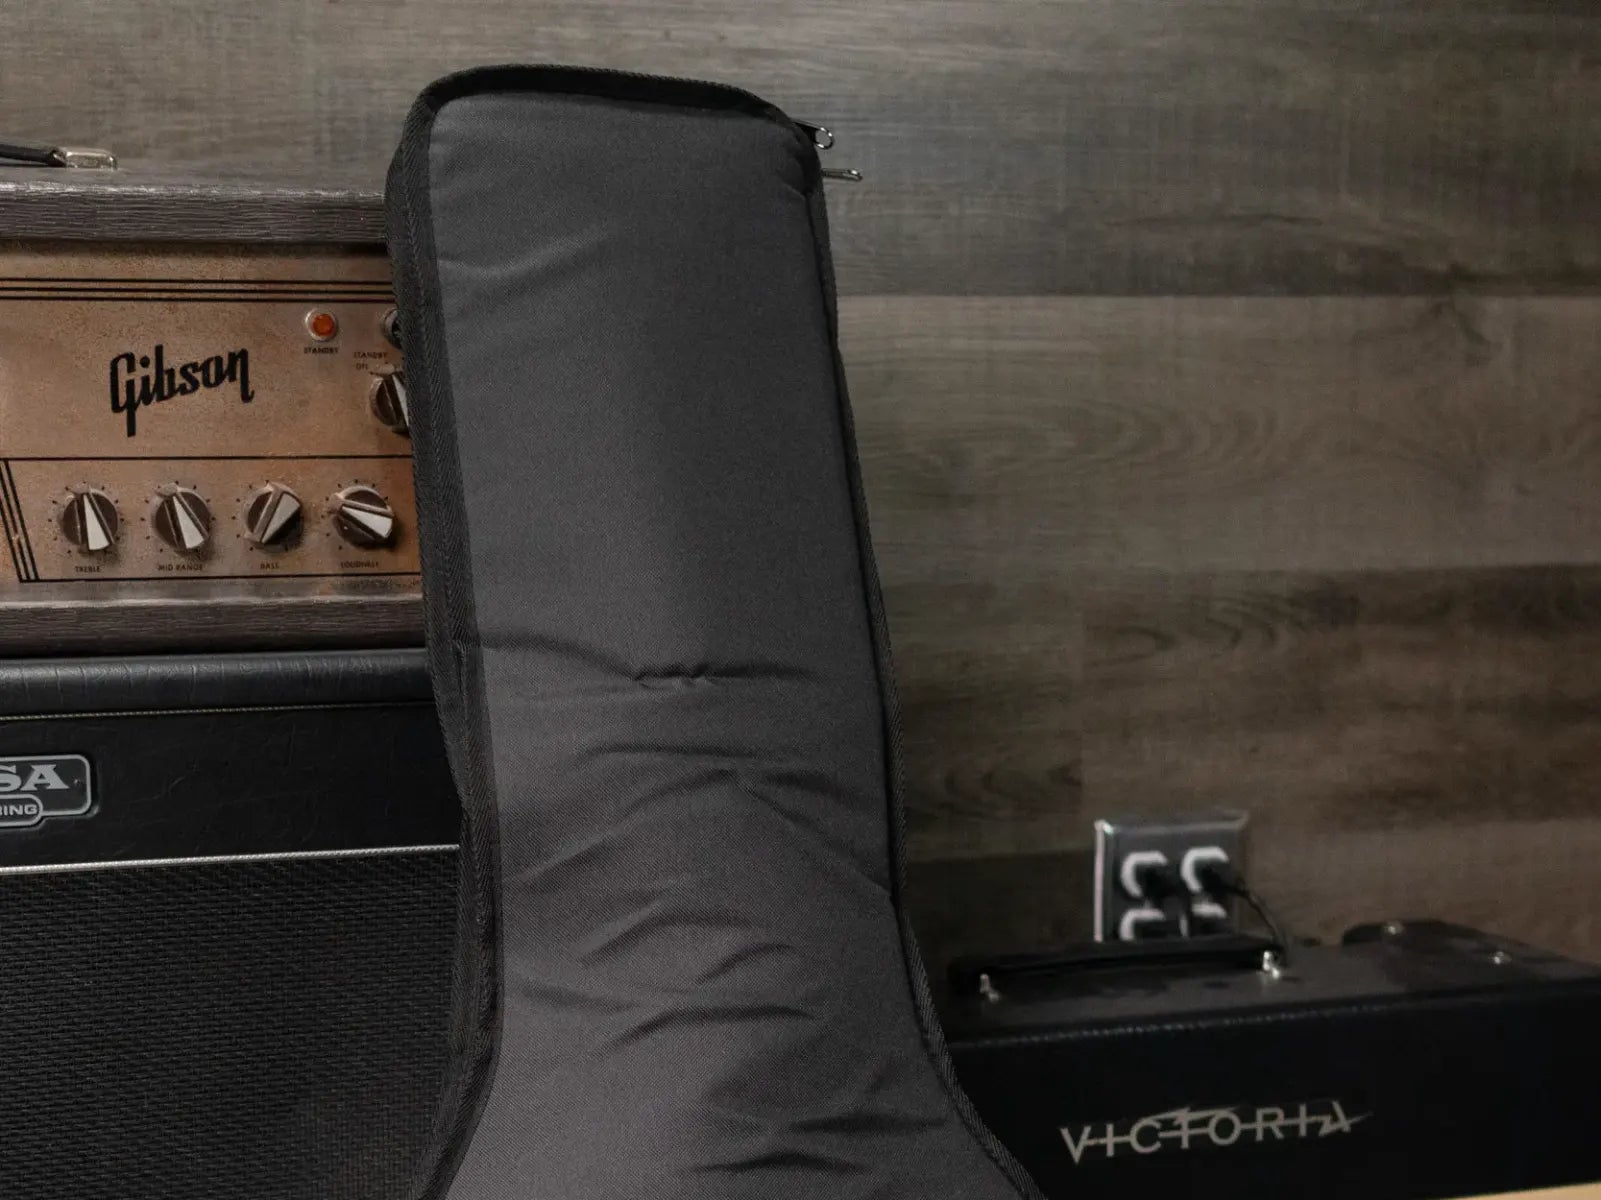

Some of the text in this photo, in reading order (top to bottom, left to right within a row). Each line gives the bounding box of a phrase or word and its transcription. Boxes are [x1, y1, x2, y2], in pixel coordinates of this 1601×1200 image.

[110, 344, 255, 438] Gibson
[75, 565, 102, 574] TREBLE
[157, 564, 174, 573] MID
[1060, 1100, 1370, 1165] VICTORIA
